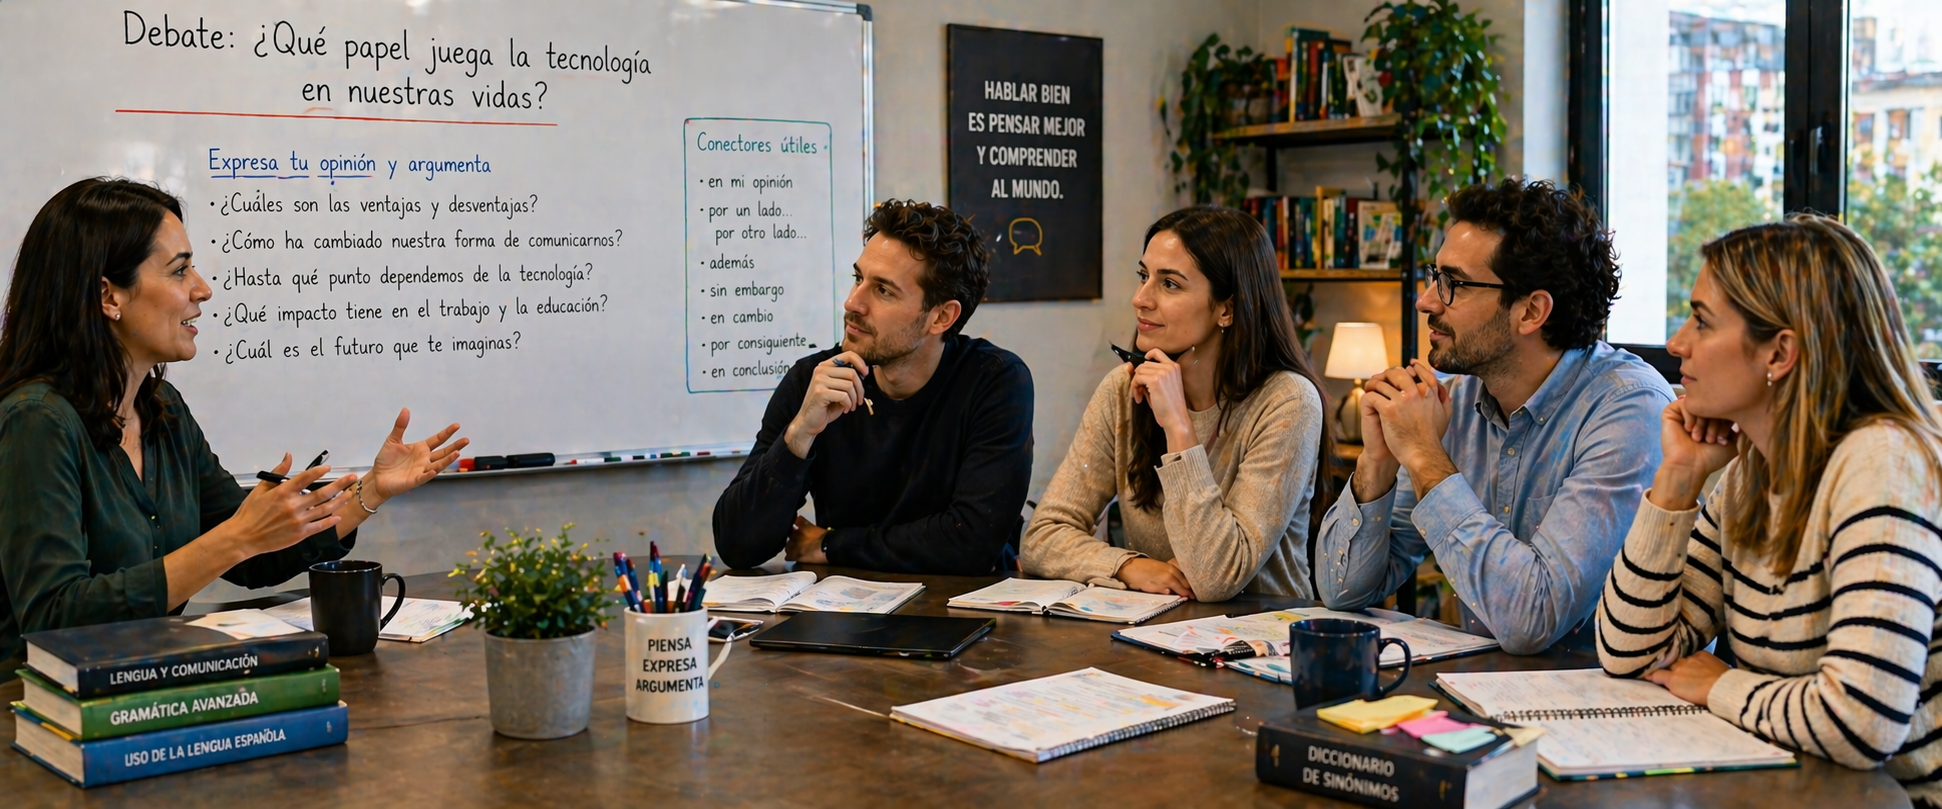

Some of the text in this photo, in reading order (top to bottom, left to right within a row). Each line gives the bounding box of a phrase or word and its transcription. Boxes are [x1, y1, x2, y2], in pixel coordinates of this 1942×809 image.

[124, 10, 651, 84] Debate: ¿Qué papel juega la tecnología
[302, 77, 547, 109] en nuestras vidas?
[985, 81, 1070, 104] HABLAR BIEN
[969, 113, 1085, 136] ES PENSAR MEJOR
[697, 132, 817, 154] Conectores útiles
[209, 147, 491, 181] Expresa tu opinión y argumenta
[977, 146, 1076, 167] Y COMPRENDER
[709, 174, 793, 194] en mi opinión
[991, 179, 1063, 199] AL MUNDO.
[221, 190, 538, 220] ¿Cuáles son las ventajas y desventajas?
[709, 207, 728, 223] por
[736, 207, 750, 216] un
[222, 229, 622, 253] ¿Cómo ha cambiado nuestra forma de comunicarnos?
[716, 230, 734, 246] por
[742, 225, 765, 239] otro
[710, 253, 754, 269] además
[224, 263, 592, 293] ¿Hasta qué punto dependemos de la tecnología?
[710, 281, 784, 302] sin embargo
[224, 294, 607, 328] ¿Qué impacto tiene en el trabajo y la educación?
[711, 308, 773, 324] en cambio
[226, 331, 521, 364] ¿Cuál es el futuro que te imaginas?
[711, 332, 806, 357] por consiguiente
[712, 359, 790, 378] en conclusión
[648, 637, 691, 652] PIENSA
[110, 654, 258, 684] LENGUA Y COMUNICACIÓN
[643, 657, 697, 673] EXPRESA
[636, 676, 704, 693] ARGUMENTA
[110, 691, 259, 725] GRAMÁTICA AVANZADA
[125, 728, 286, 766] USO DE LA LENGUA ESPAÑOLA
[1308, 745, 1395, 778] DICCIONARIO
[1303, 767, 1400, 802] DE SINÓNIMOS
